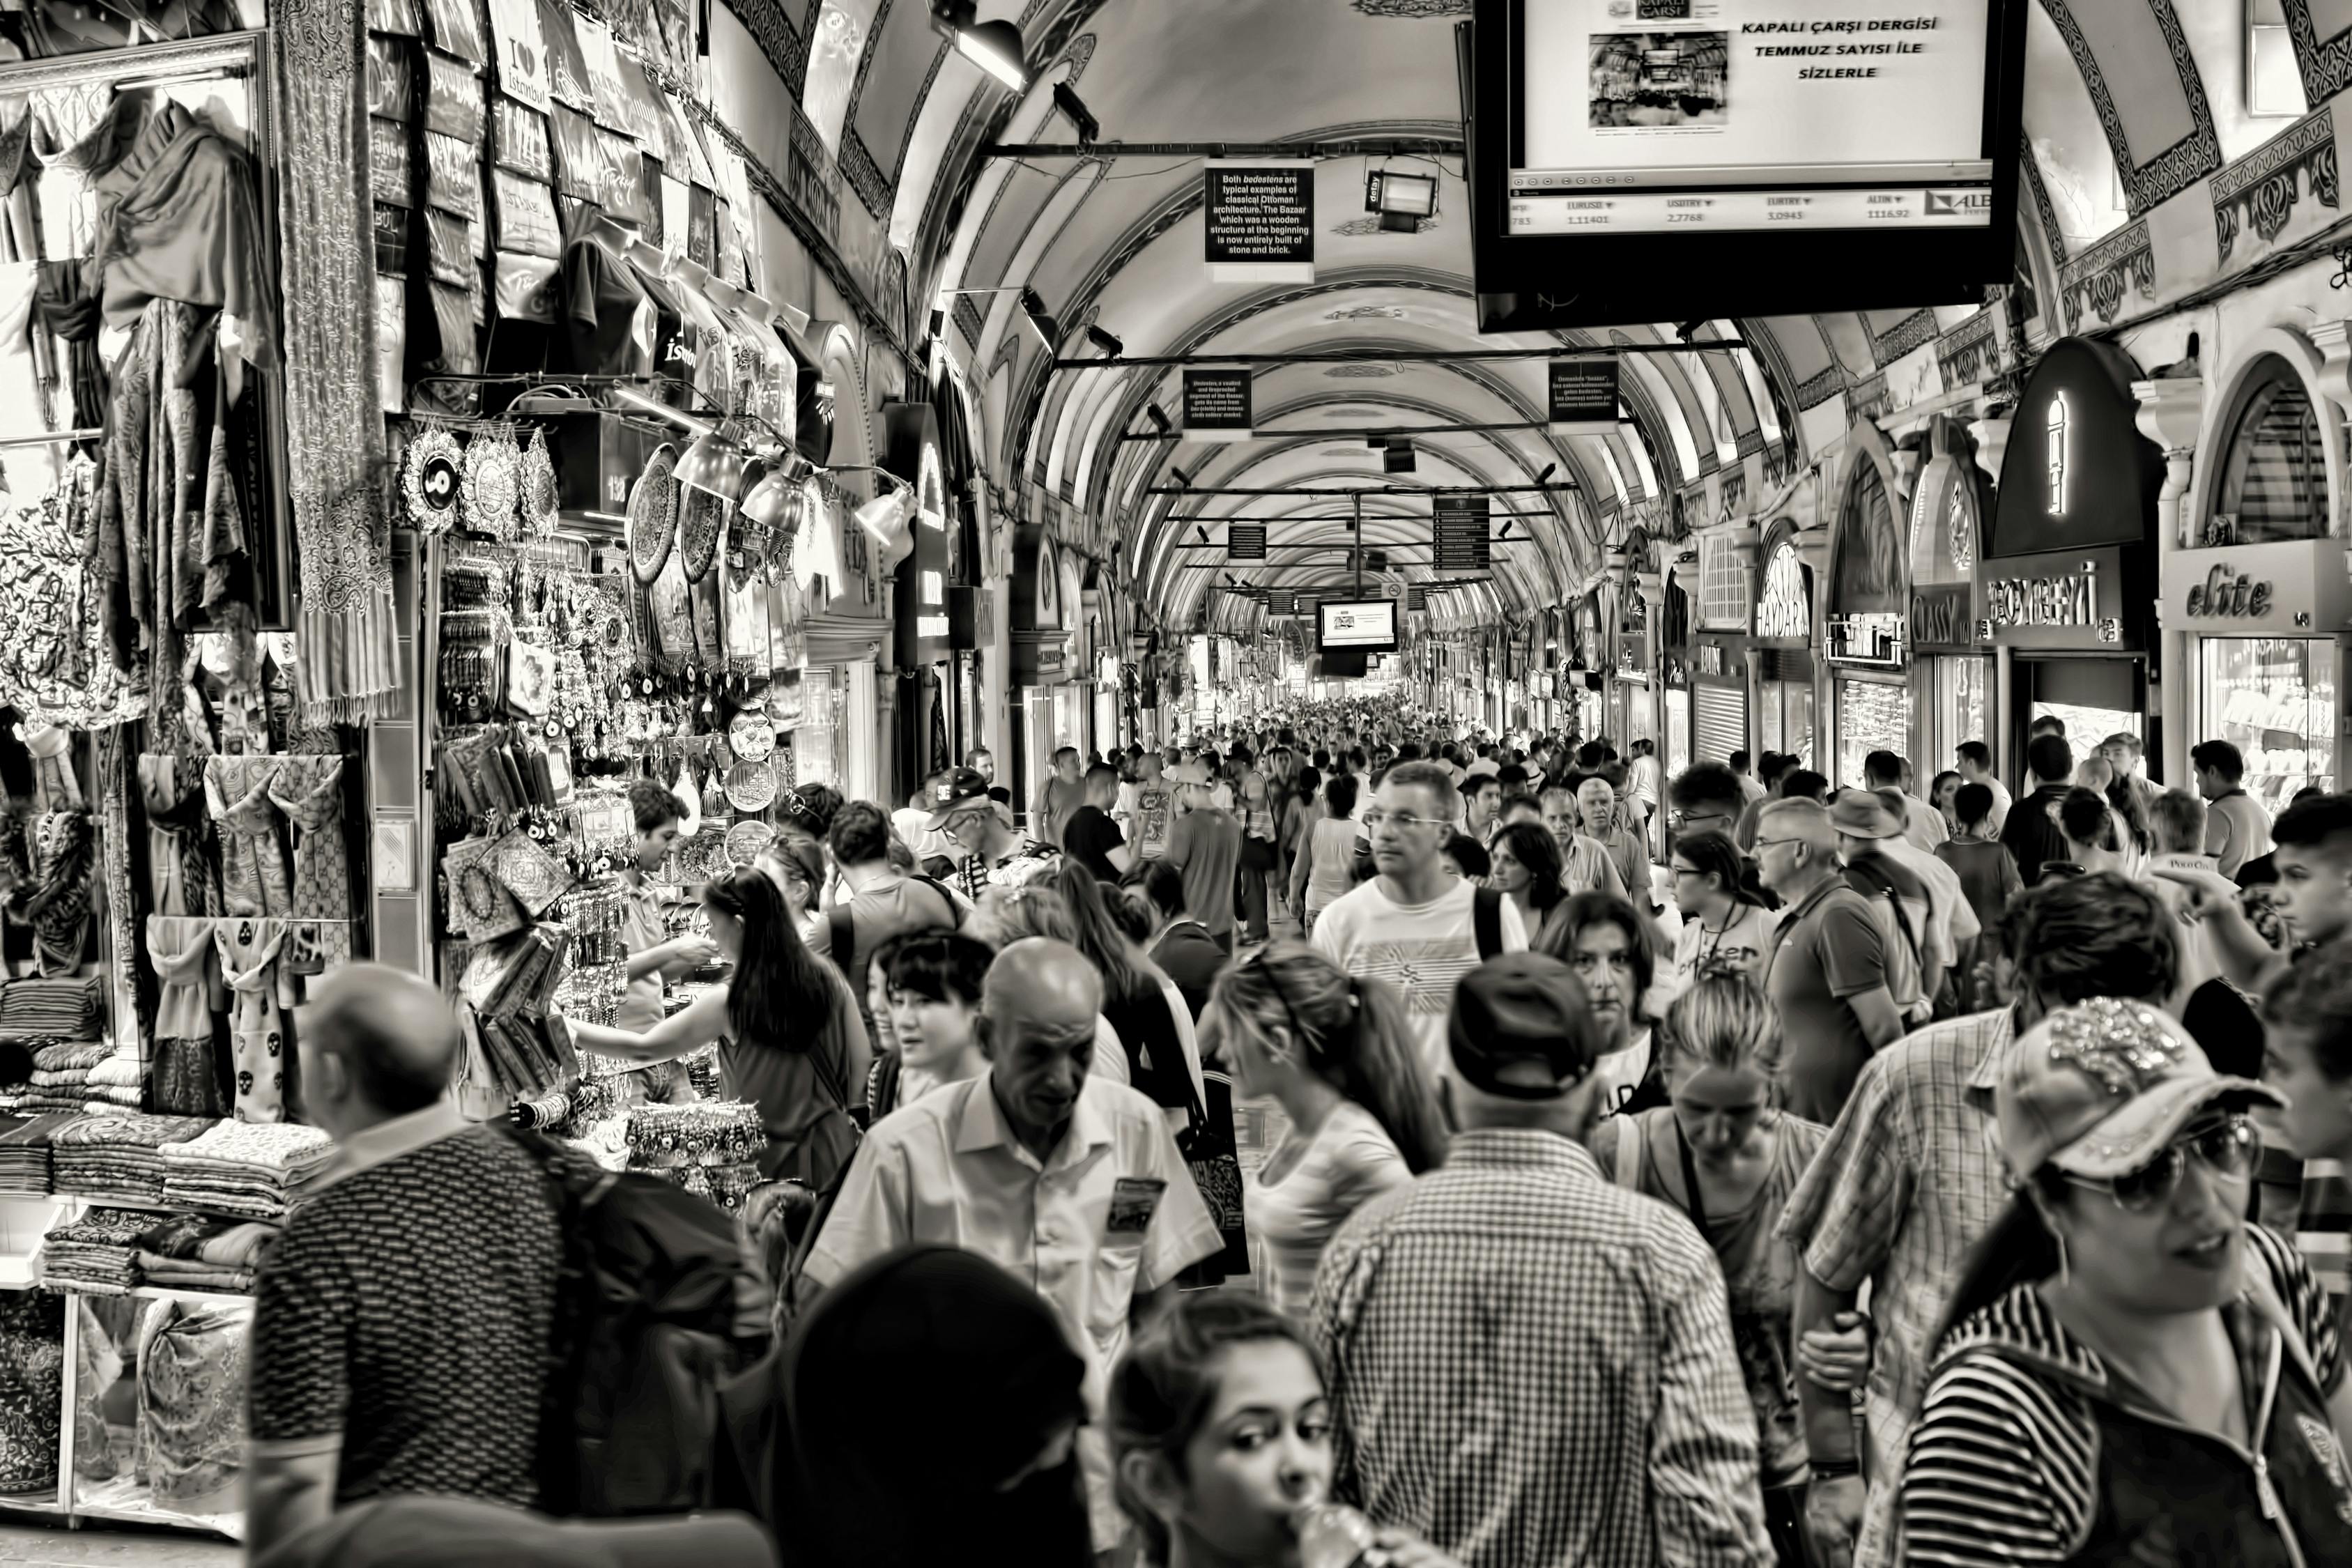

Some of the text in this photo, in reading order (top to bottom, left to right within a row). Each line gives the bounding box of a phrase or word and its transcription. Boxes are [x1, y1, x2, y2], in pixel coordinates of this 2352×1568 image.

[1640, 6, 1681, 17] ÇARŞI
[1742, 17, 1938, 34] KAPALI ÇARŞI DERGİSİ
[1755, 40, 1923, 56] TEMMUZ SAYISI İLE
[1798, 66, 1877, 79] SİZLERLE
[1222, 175, 1241, 183] Both
[1243, 175, 1284, 183] bedestens
[1222, 185, 1297, 196] typical examples of
[1225, 195, 1295, 204] classical Ottoman
[1867, 194, 1891, 204] ALTIN
[1263, 205, 1278, 214] The
[1279, 205, 1307, 214] Bazaar
[1220, 215, 1243, 224] which
[1268, 215, 1299, 224] wooden
[1210, 225, 1309, 236] structure at the beginning
[1217, 236, 1224, 244] is
[1244, 236, 1273, 246] entirely
[1275, 236, 1292, 244] built
[1293, 236, 1302, 244] of
[1252, 245, 1267, 254] and
[2187, 562, 2272, 617] elite
